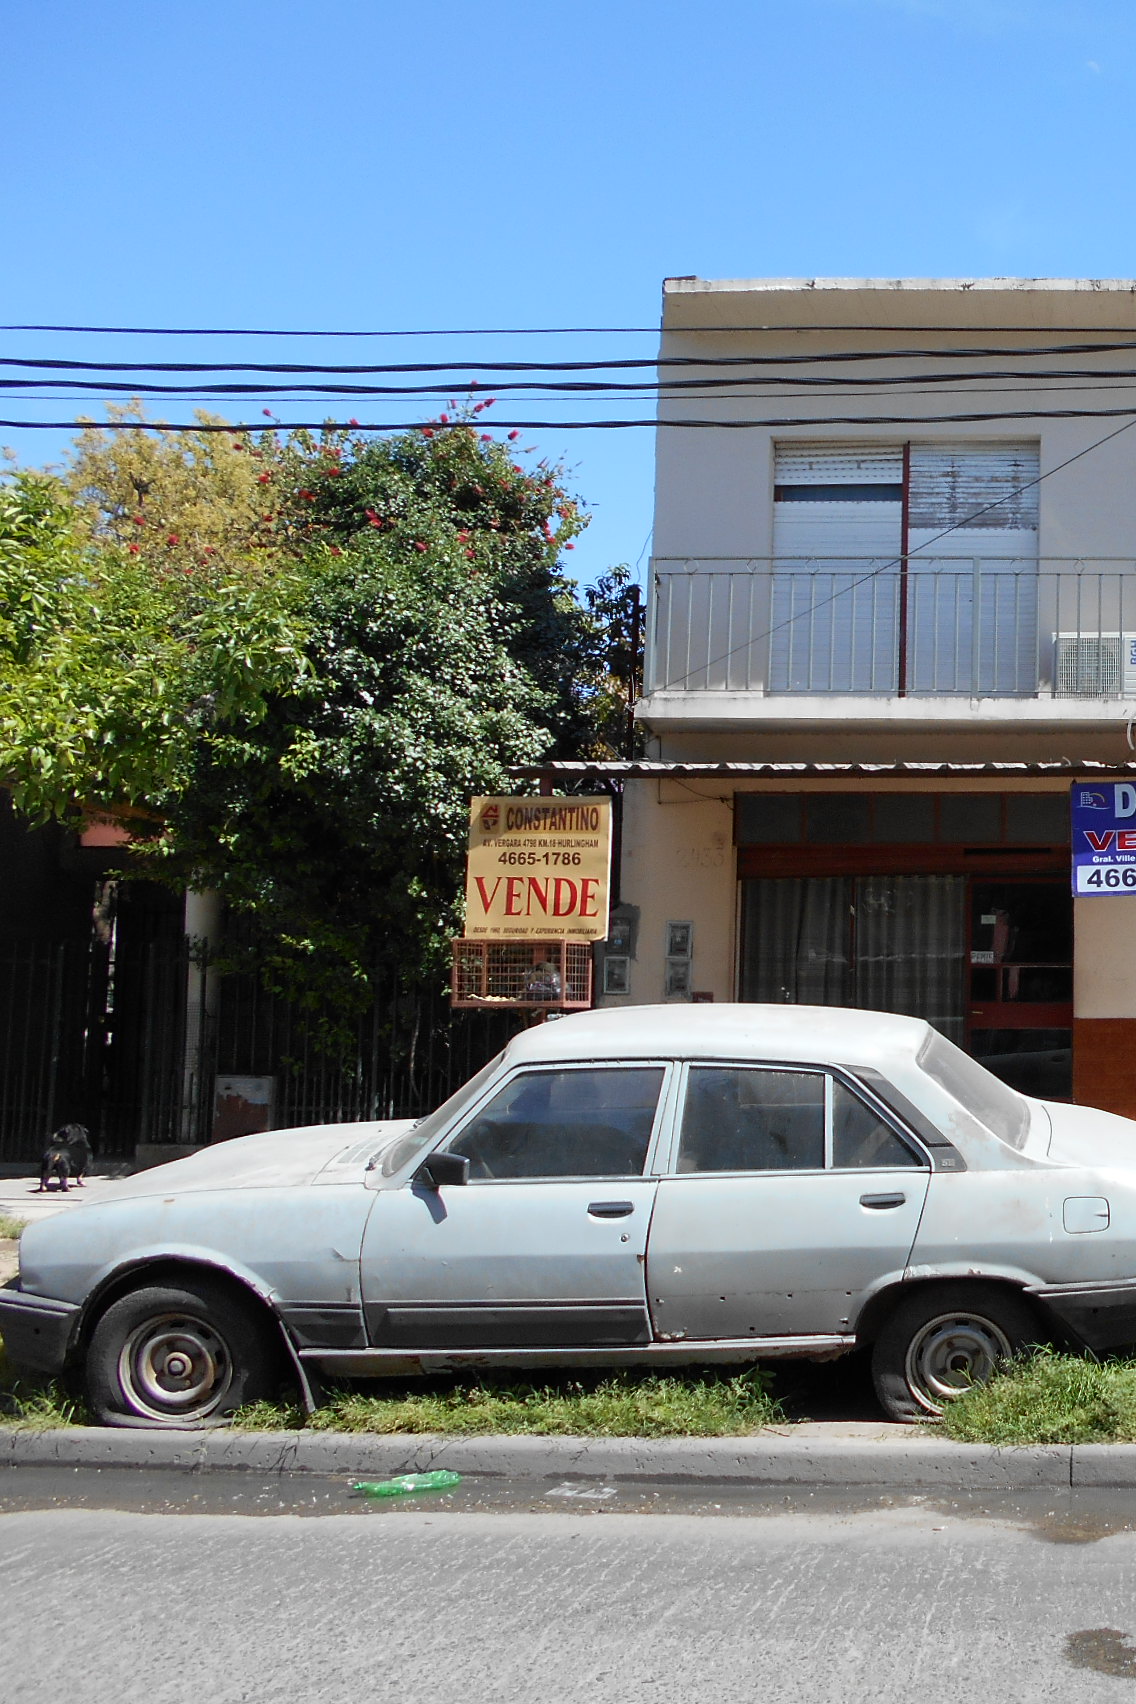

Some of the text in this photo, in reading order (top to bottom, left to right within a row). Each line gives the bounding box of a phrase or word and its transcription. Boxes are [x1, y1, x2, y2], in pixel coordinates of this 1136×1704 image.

[506, 806, 599, 831] CONSTANTINO
[494, 839, 522, 848] VERGARA
[497, 851, 582, 866] 4665-1786
[1092, 855, 1114, 863] Gral.
[473, 876, 600, 918] VENDE
